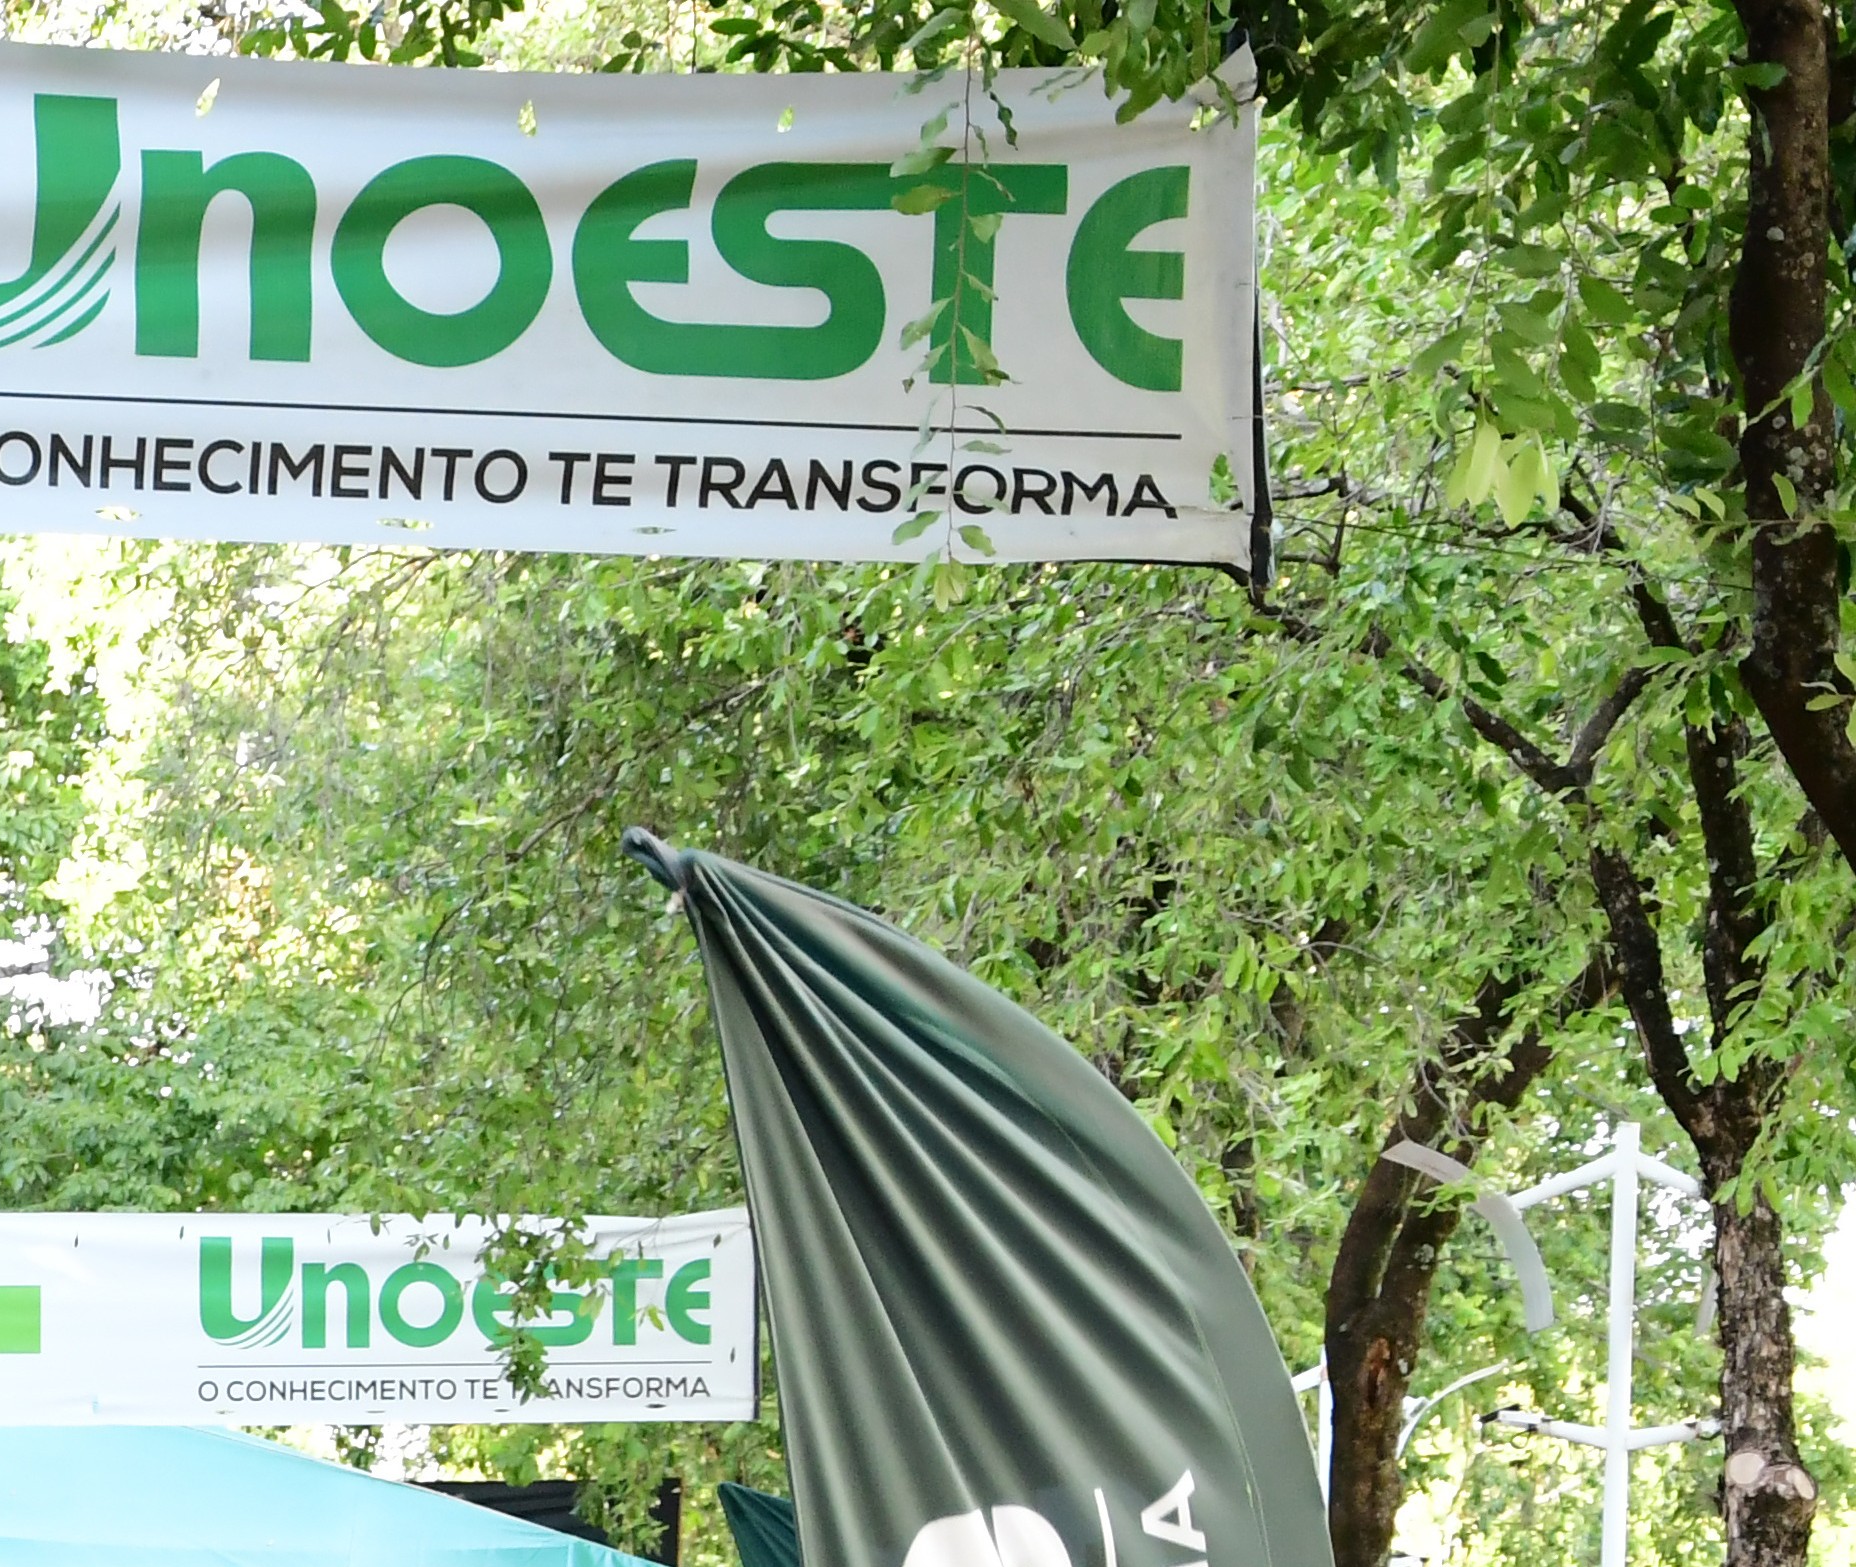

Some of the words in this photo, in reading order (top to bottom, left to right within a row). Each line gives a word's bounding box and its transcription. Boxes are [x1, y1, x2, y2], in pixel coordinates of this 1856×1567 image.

[548, 451, 637, 508] TE
[652, 455, 1179, 520] TRANSFORMA
[198, 1380, 220, 1402] O
[226, 1379, 457, 1401] CONHECIMENTO
[465, 1379, 500, 1400] TE
[504, 1376, 711, 1400] TANSFORMA
